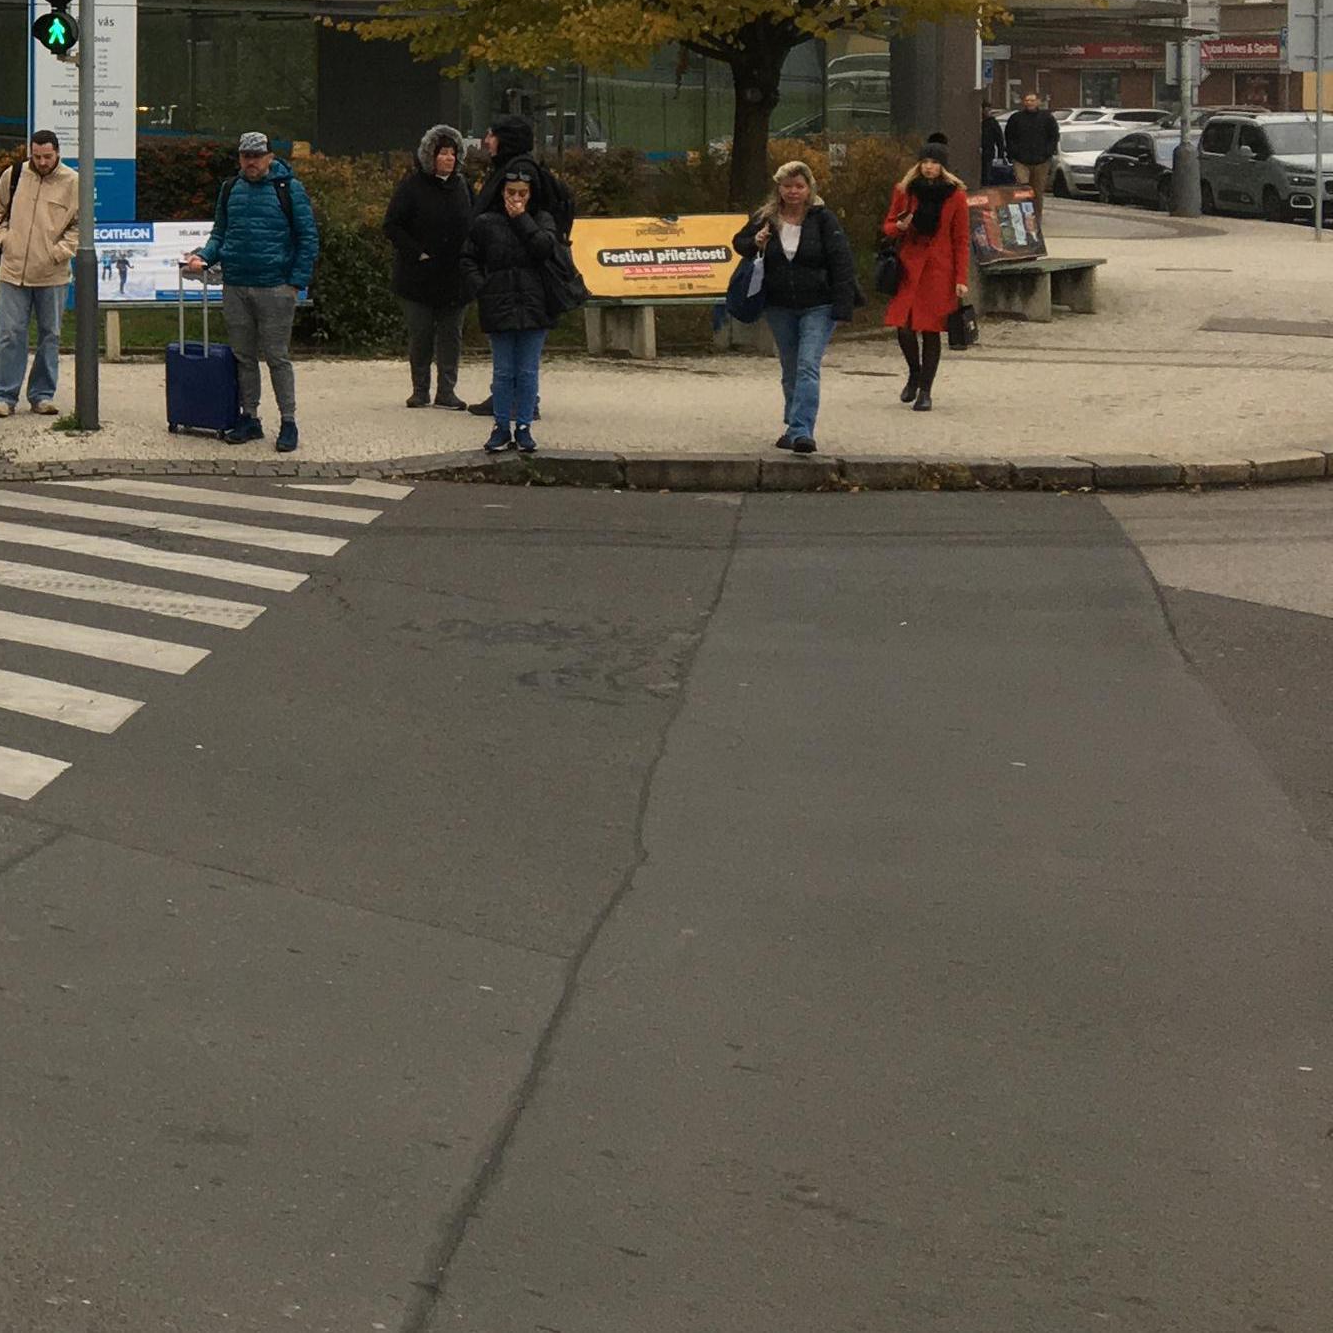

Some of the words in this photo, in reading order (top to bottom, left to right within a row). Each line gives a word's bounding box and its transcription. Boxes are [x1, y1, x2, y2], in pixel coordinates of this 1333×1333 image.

[94, 228, 150, 240] ECATHLON
[602, 250, 654, 264] Festival
[657, 247, 726, 265] příležitostí
